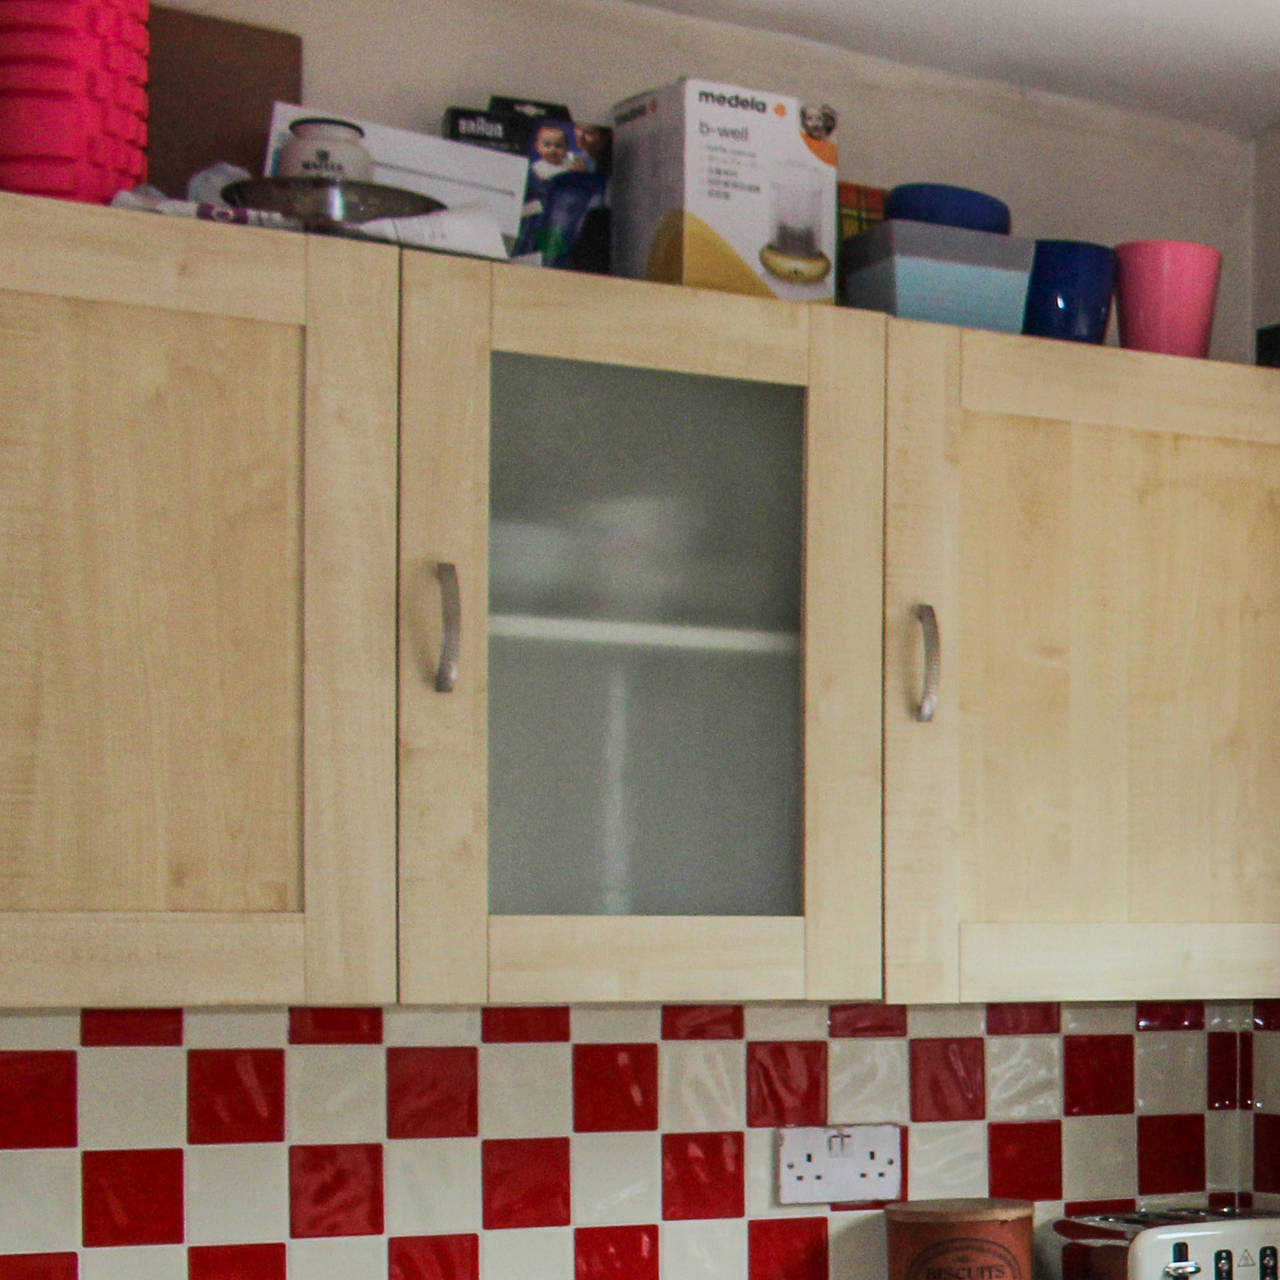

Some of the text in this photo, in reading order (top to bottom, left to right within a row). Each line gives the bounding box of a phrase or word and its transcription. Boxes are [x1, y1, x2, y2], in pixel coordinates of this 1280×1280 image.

[698, 90, 767, 113] medela
[698, 119, 749, 142] b-well
[926, 1264, 1005, 1280] BISCUITS
